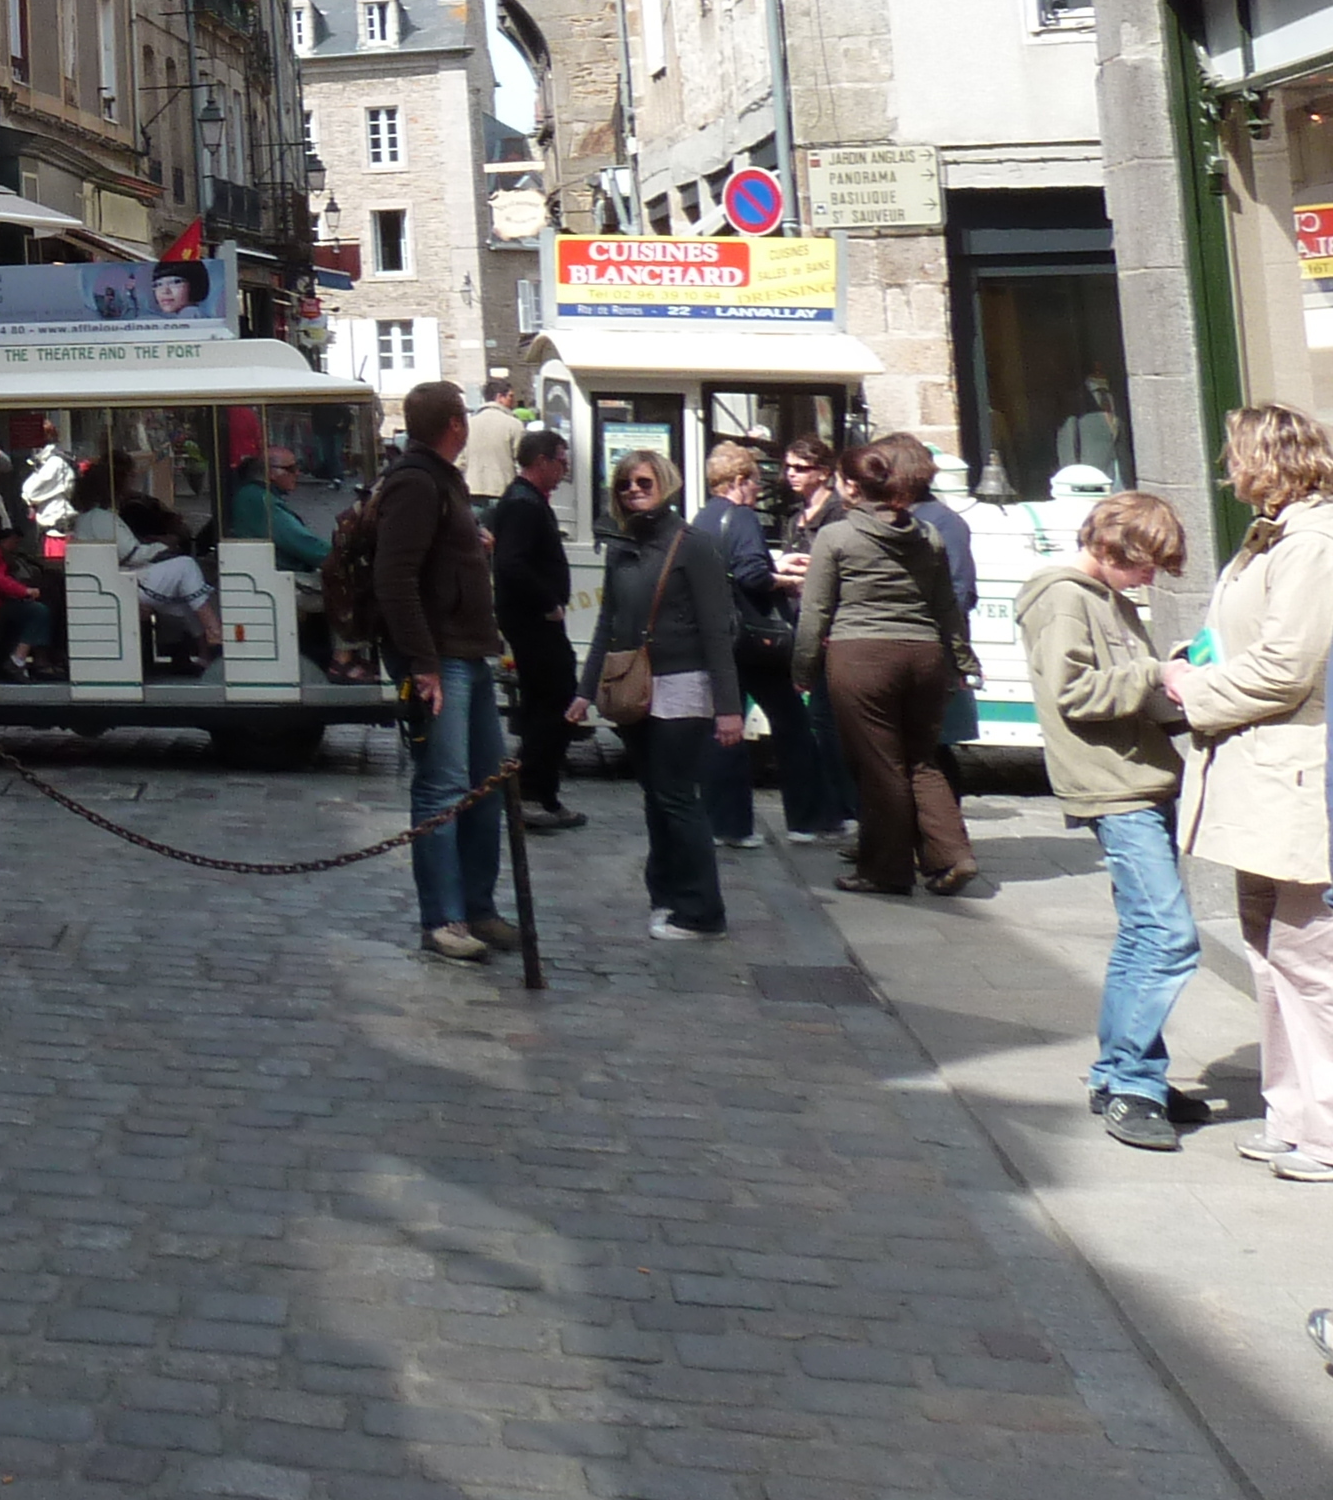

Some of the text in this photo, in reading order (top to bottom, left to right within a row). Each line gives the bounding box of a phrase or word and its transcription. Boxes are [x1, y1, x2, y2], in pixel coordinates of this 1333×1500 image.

[828, 150, 916, 166] JARDIN ANGLAIS
[829, 170, 897, 184] PANORAMA
[830, 190, 897, 205] BASILIQUE
[852, 209, 906, 223] SAUVEUR
[588, 242, 720, 262] CUISINES
[769, 244, 810, 261] CUISINES
[805, 259, 831, 274] BAINS
[567, 264, 744, 287] BLANCHARD
[613, 290, 632, 300] 02
[636, 290, 656, 301] 96
[660, 291, 680, 301] 39
[684, 291, 699, 301] 10
[703, 292, 722, 301] 94
[737, 282, 836, 306] DRESSING
[667, 306, 692, 317] 22
[715, 307, 819, 319] LANVALLAY
[4, 349, 30, 362] THE
[36, 347, 96, 361] THEATRE
[98, 346, 126, 360] AND
[135, 345, 160, 359] THE
[166, 344, 203, 358] PORT
